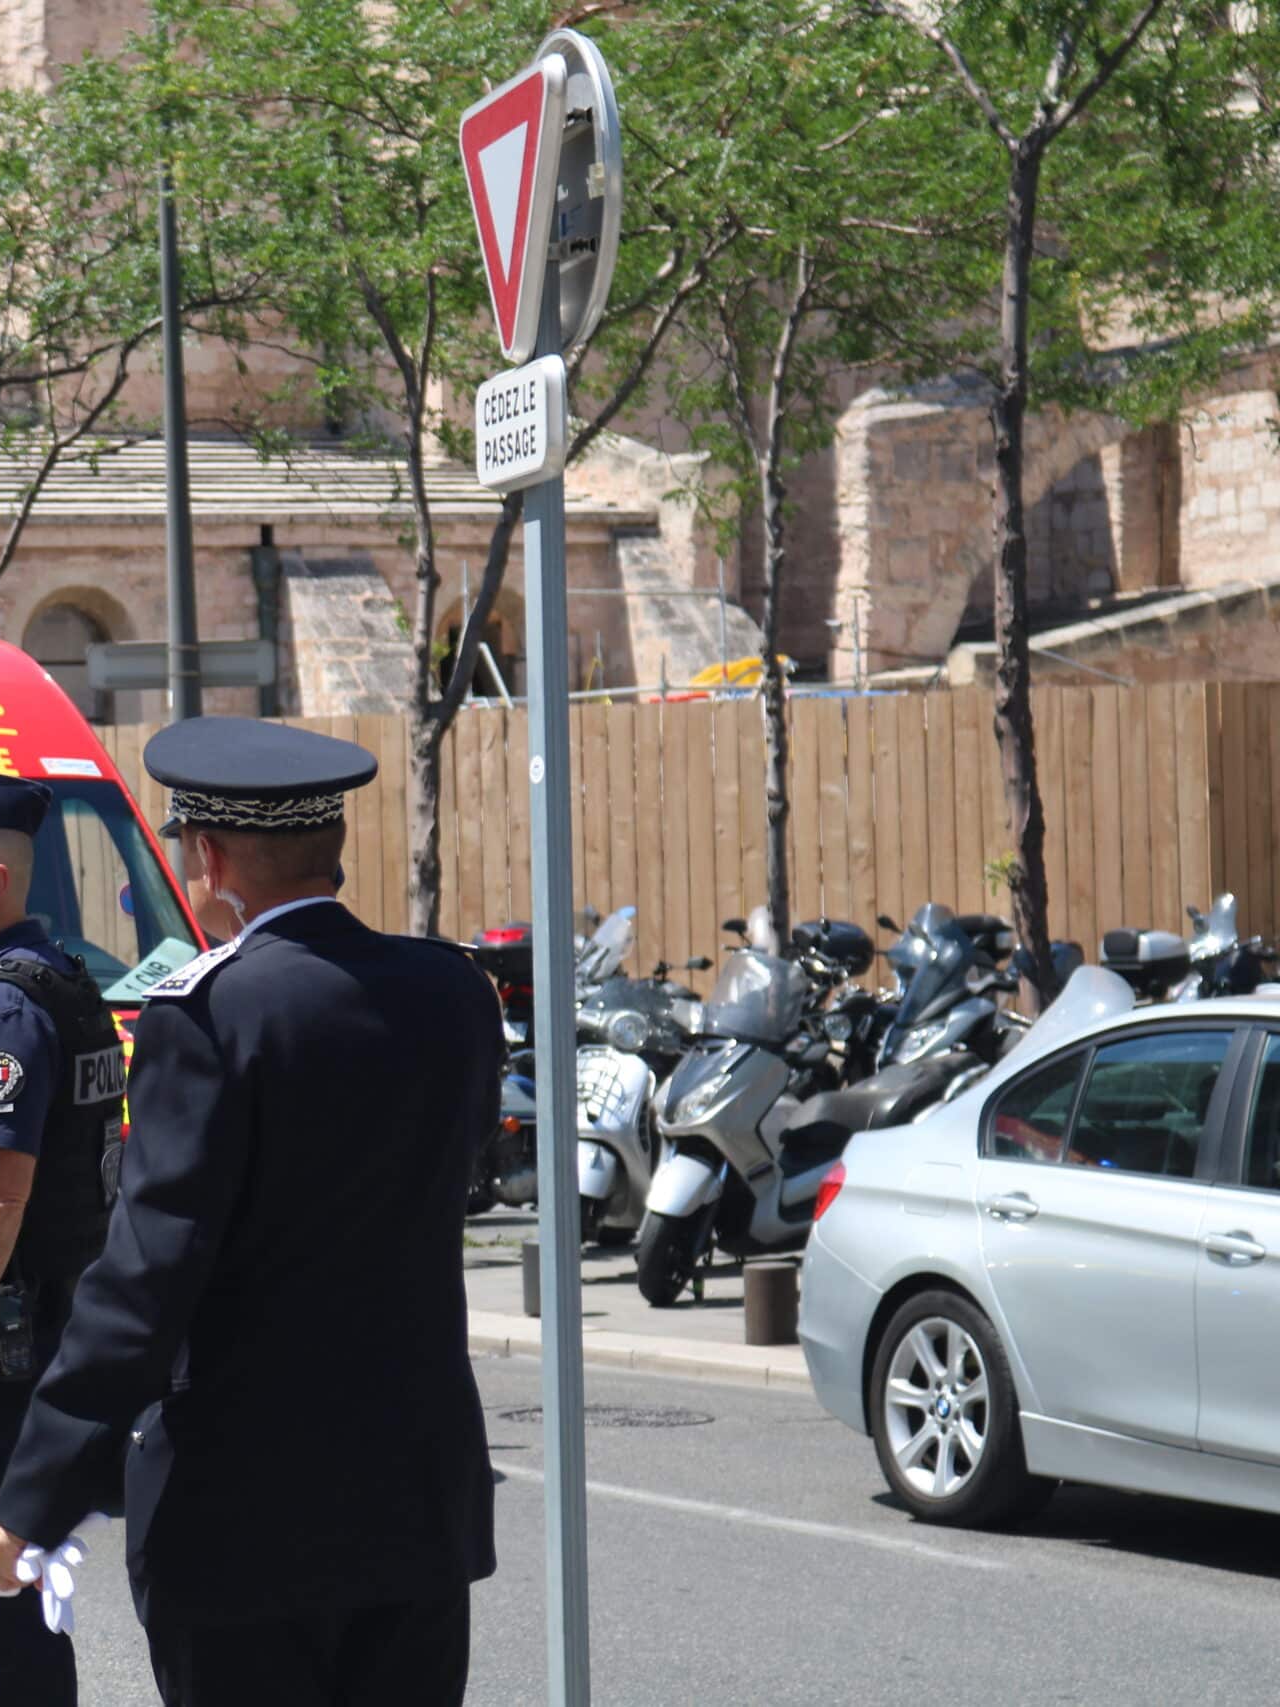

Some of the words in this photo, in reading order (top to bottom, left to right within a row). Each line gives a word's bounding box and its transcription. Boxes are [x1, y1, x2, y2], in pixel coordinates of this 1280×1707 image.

[484, 387, 520, 427] CÉDEZ
[523, 381, 536, 413] LE
[485, 424, 536, 470] PASSAGE
